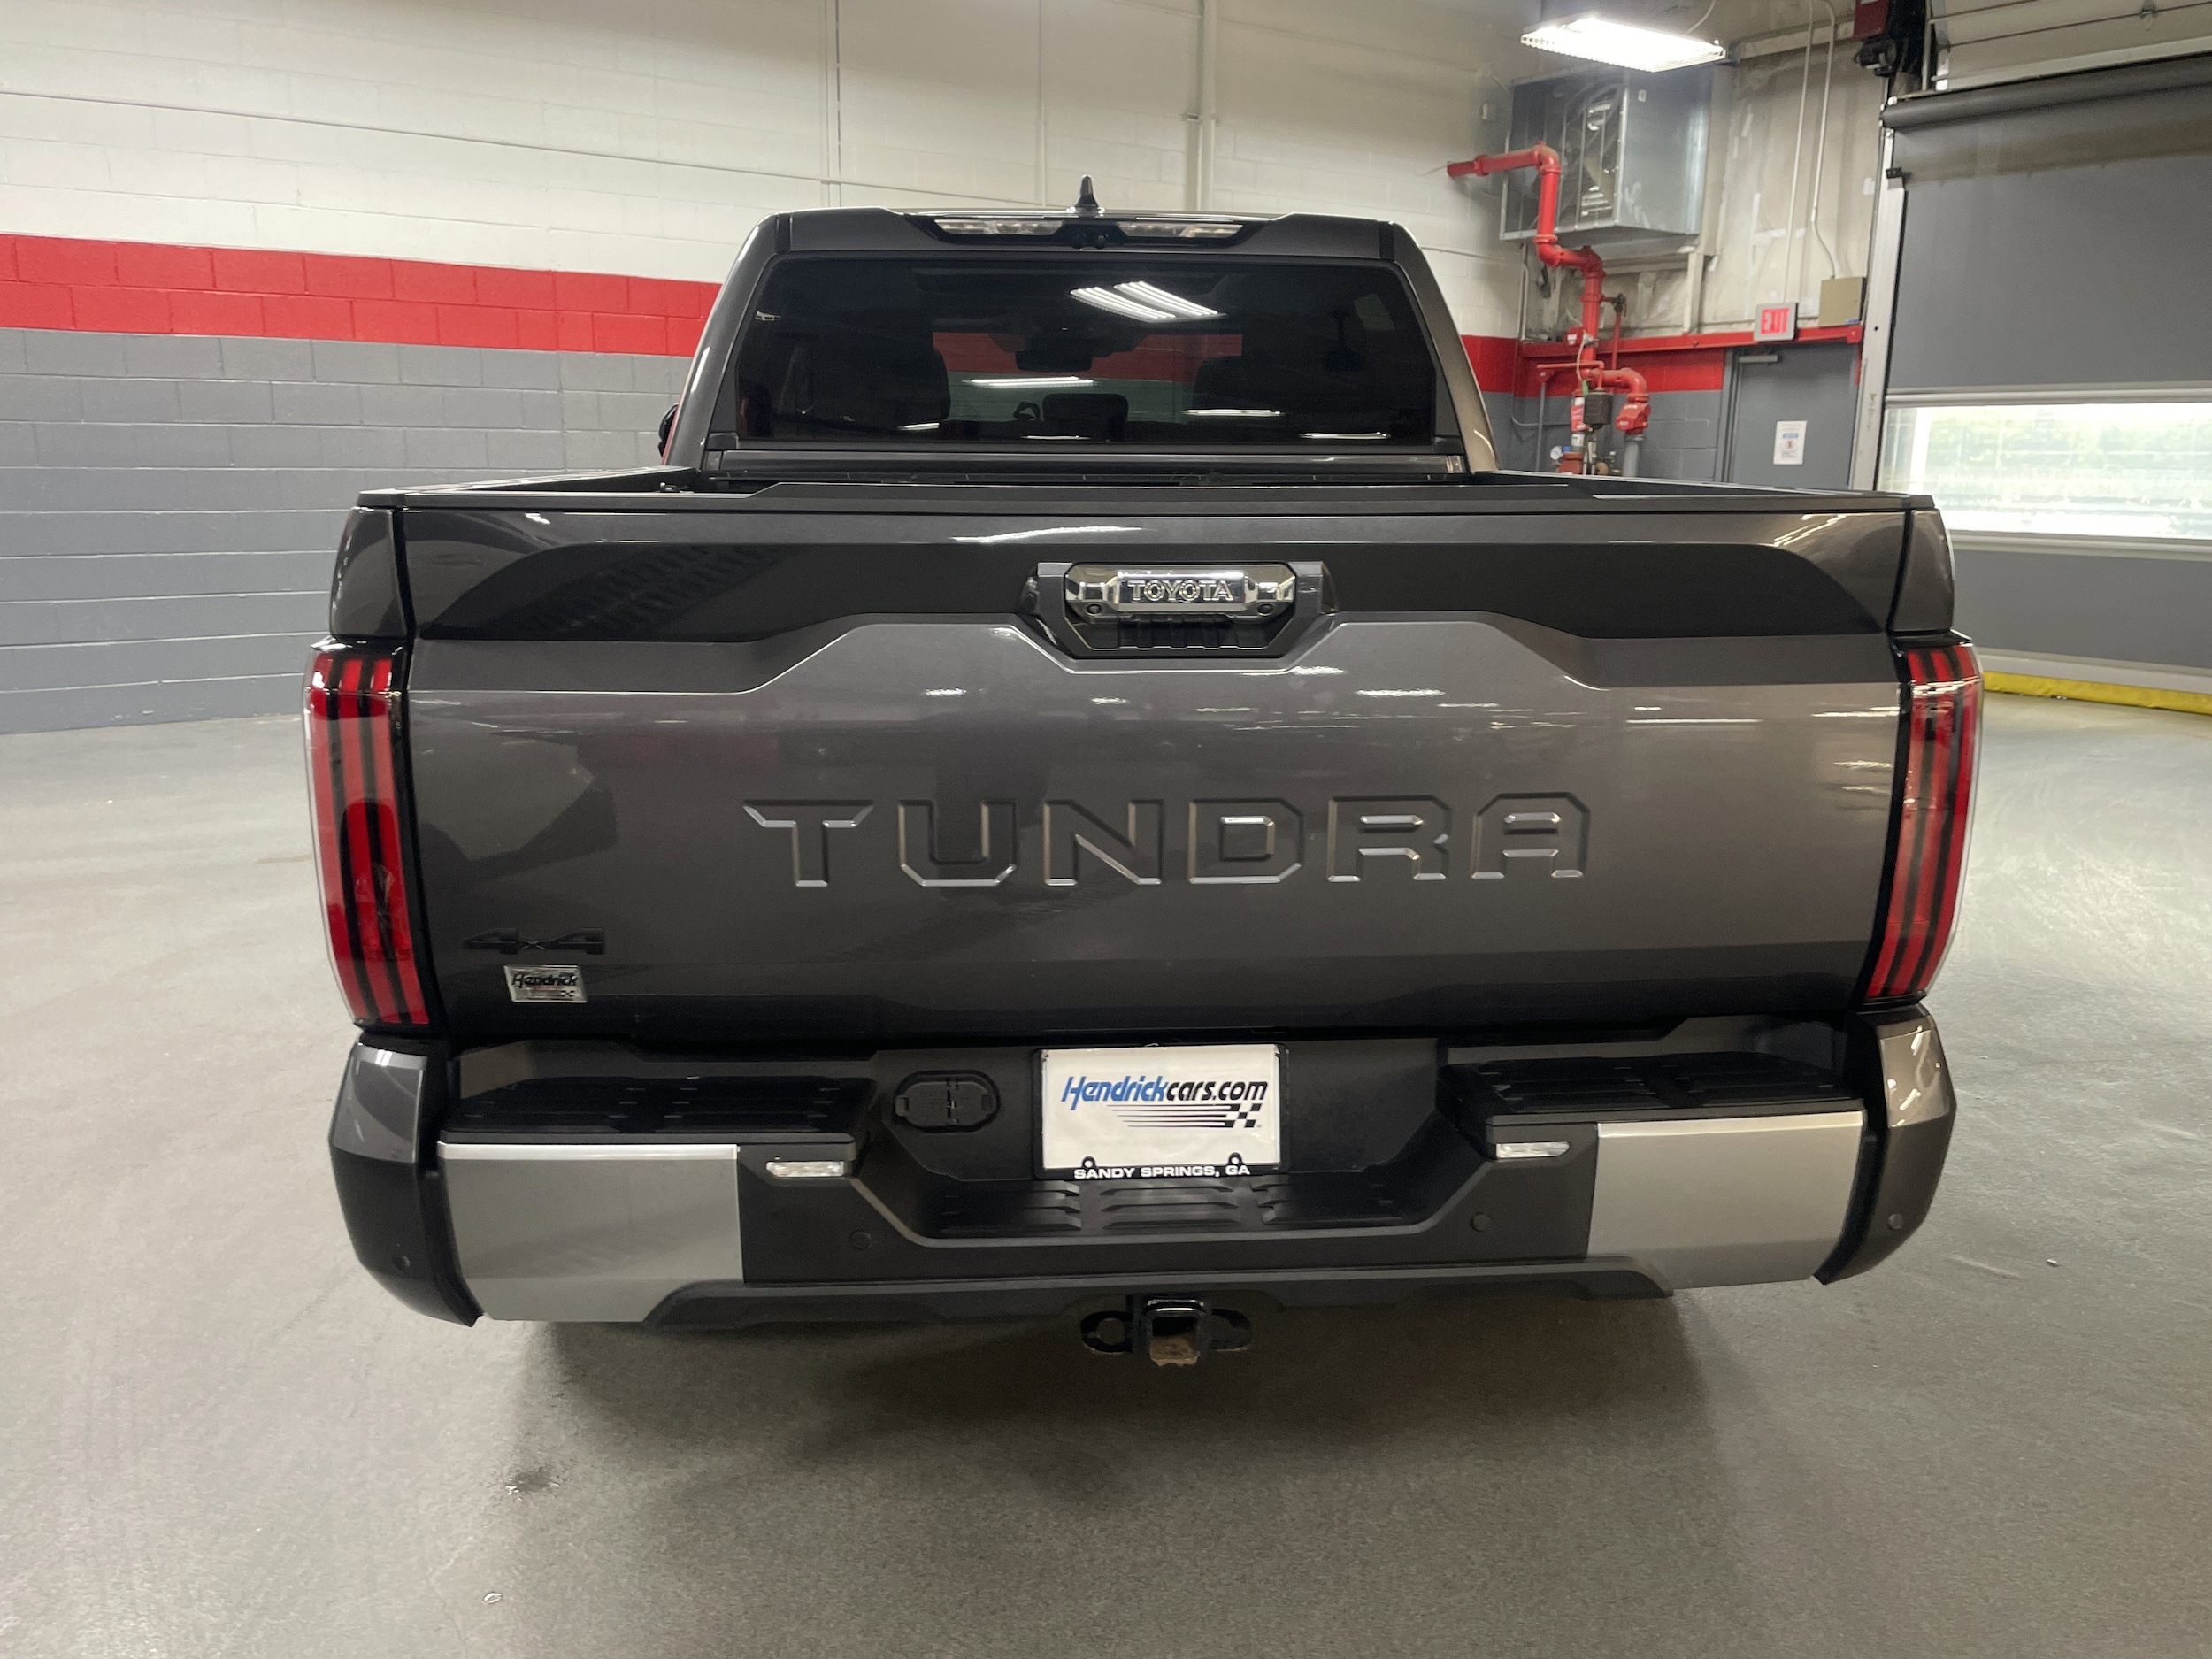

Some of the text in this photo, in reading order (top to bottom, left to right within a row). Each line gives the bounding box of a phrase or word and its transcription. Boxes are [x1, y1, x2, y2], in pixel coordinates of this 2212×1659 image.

[1760, 307, 1790, 335] EXIT
[1127, 579, 1233, 602] TOYOTA
[742, 790, 1591, 887] TUNDRA
[1061, 1075, 1269, 1110] Hendrickcars.com
[1073, 1164, 1251, 1179] SANDY SPRINGS, GA
